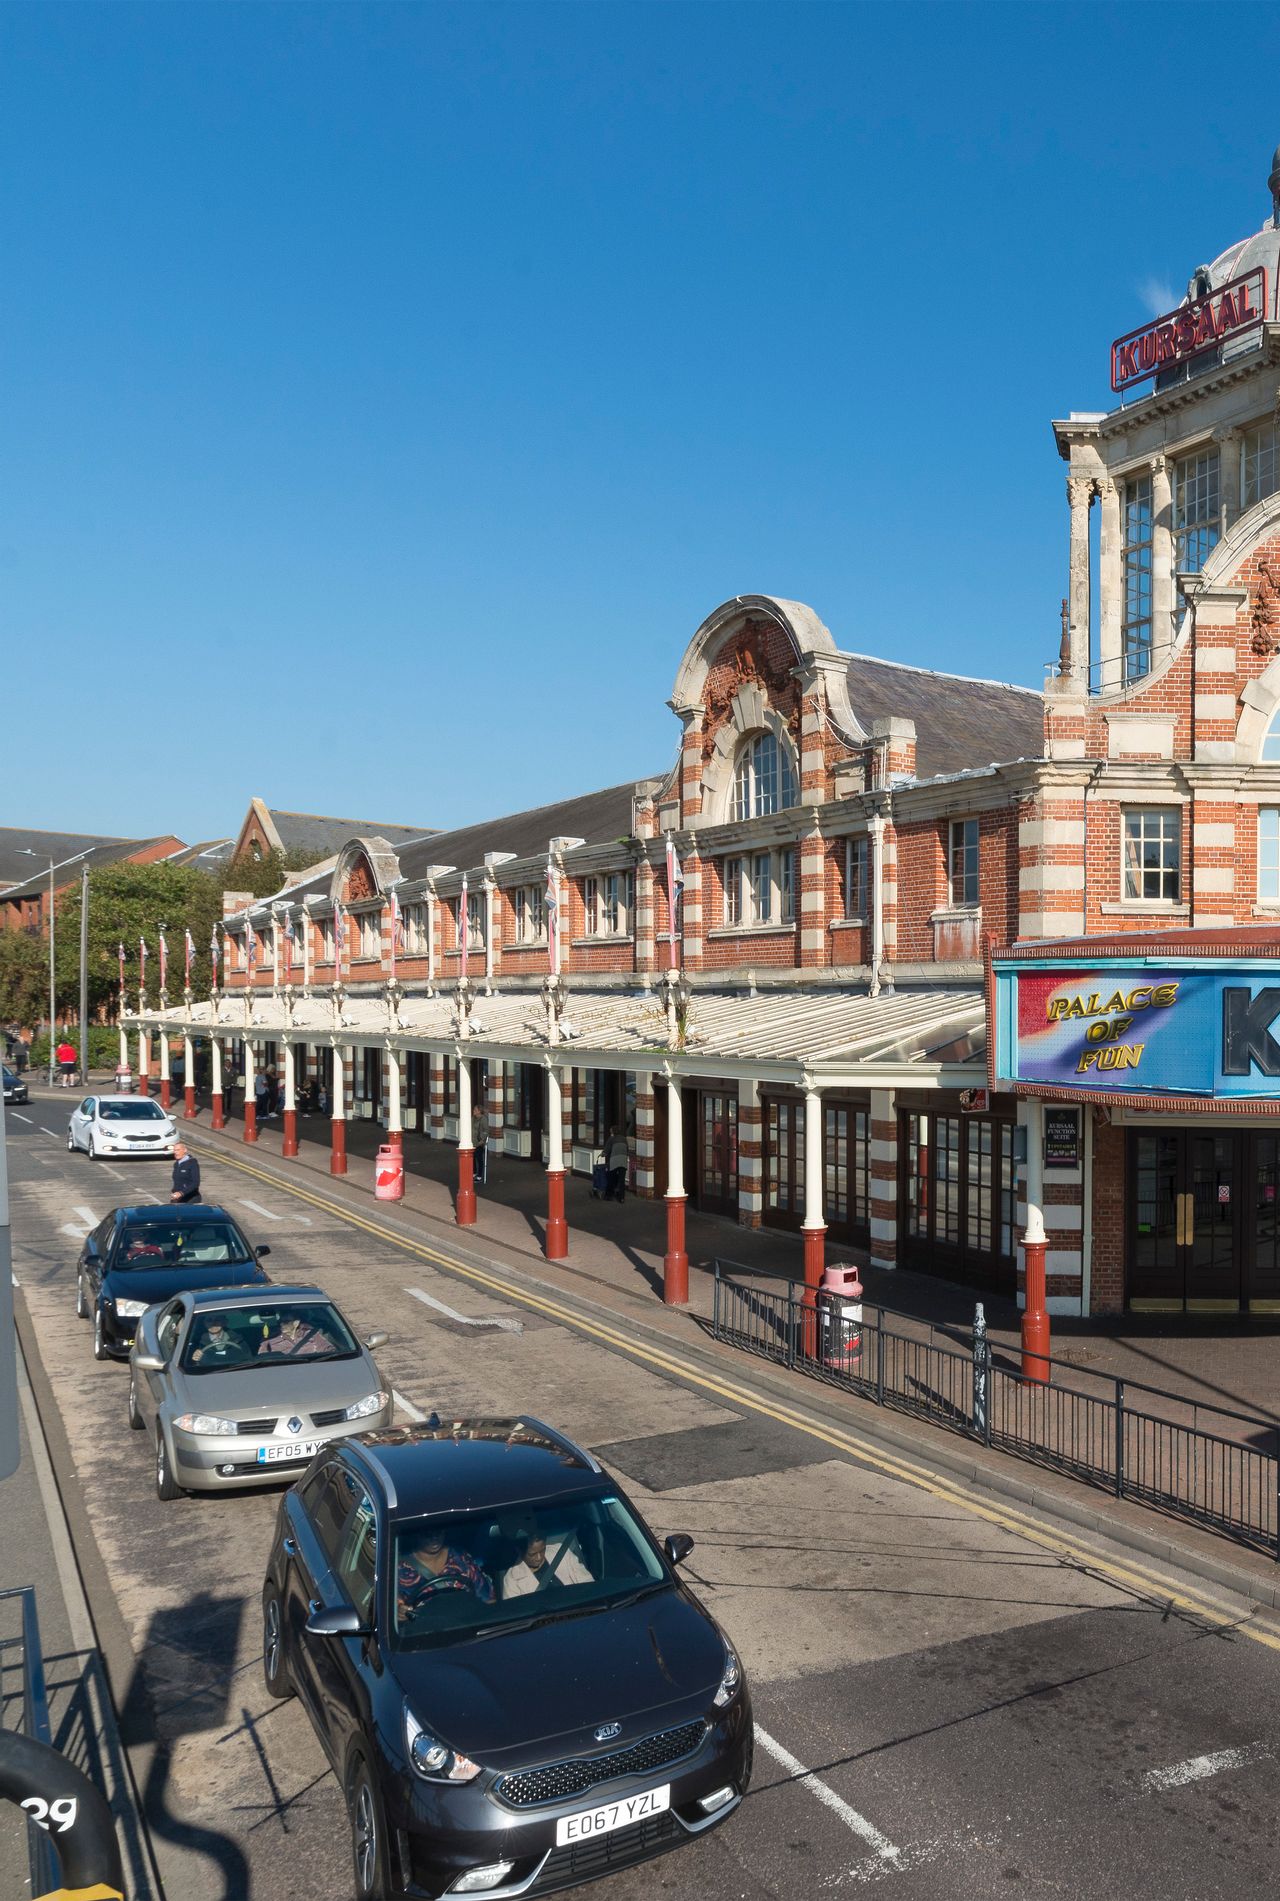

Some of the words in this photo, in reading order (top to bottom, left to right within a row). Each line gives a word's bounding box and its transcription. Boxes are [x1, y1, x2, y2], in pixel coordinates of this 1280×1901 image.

[1119, 284, 1257, 381] KURSAAL
[1048, 983, 1179, 1022] PALACE
[1086, 1017, 1133, 1044] OF
[1075, 1043, 1145, 1074] FUN
[268, 1444, 301, 1459] EF05
[305, 1441, 326, 1454] WY
[597, 1724, 619, 1738] KIA
[20, 1797, 77, 1833] 29
[567, 1806, 619, 1839] EO67
[626, 1793, 661, 1819] YZL
